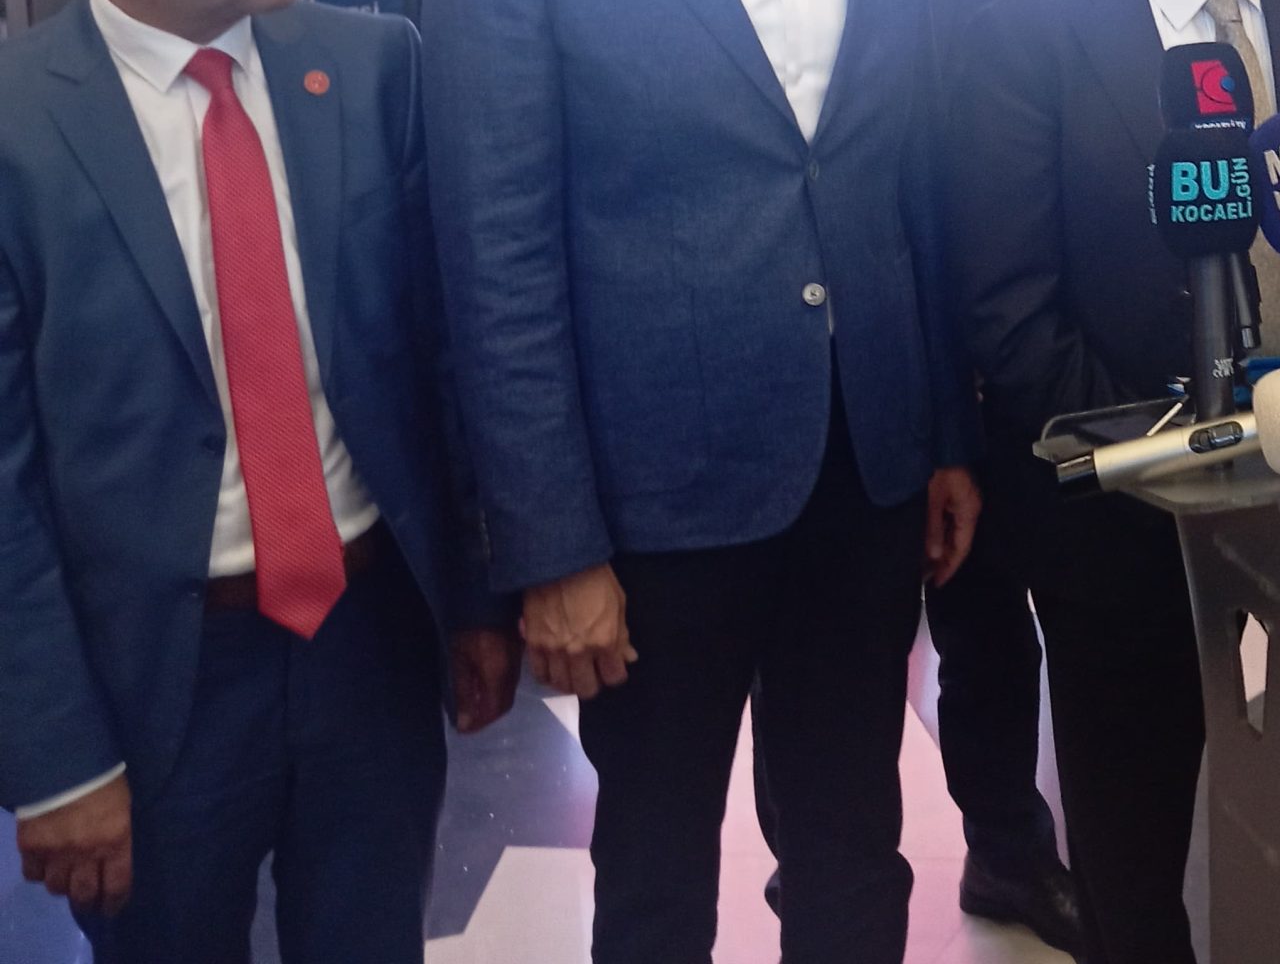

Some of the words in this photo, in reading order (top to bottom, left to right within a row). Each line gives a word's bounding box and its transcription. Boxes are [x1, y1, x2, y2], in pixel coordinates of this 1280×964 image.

[1172, 160, 1230, 201] BU
[1231, 157, 1251, 198] GÜN
[1171, 197, 1252, 223] KOCAELİ
